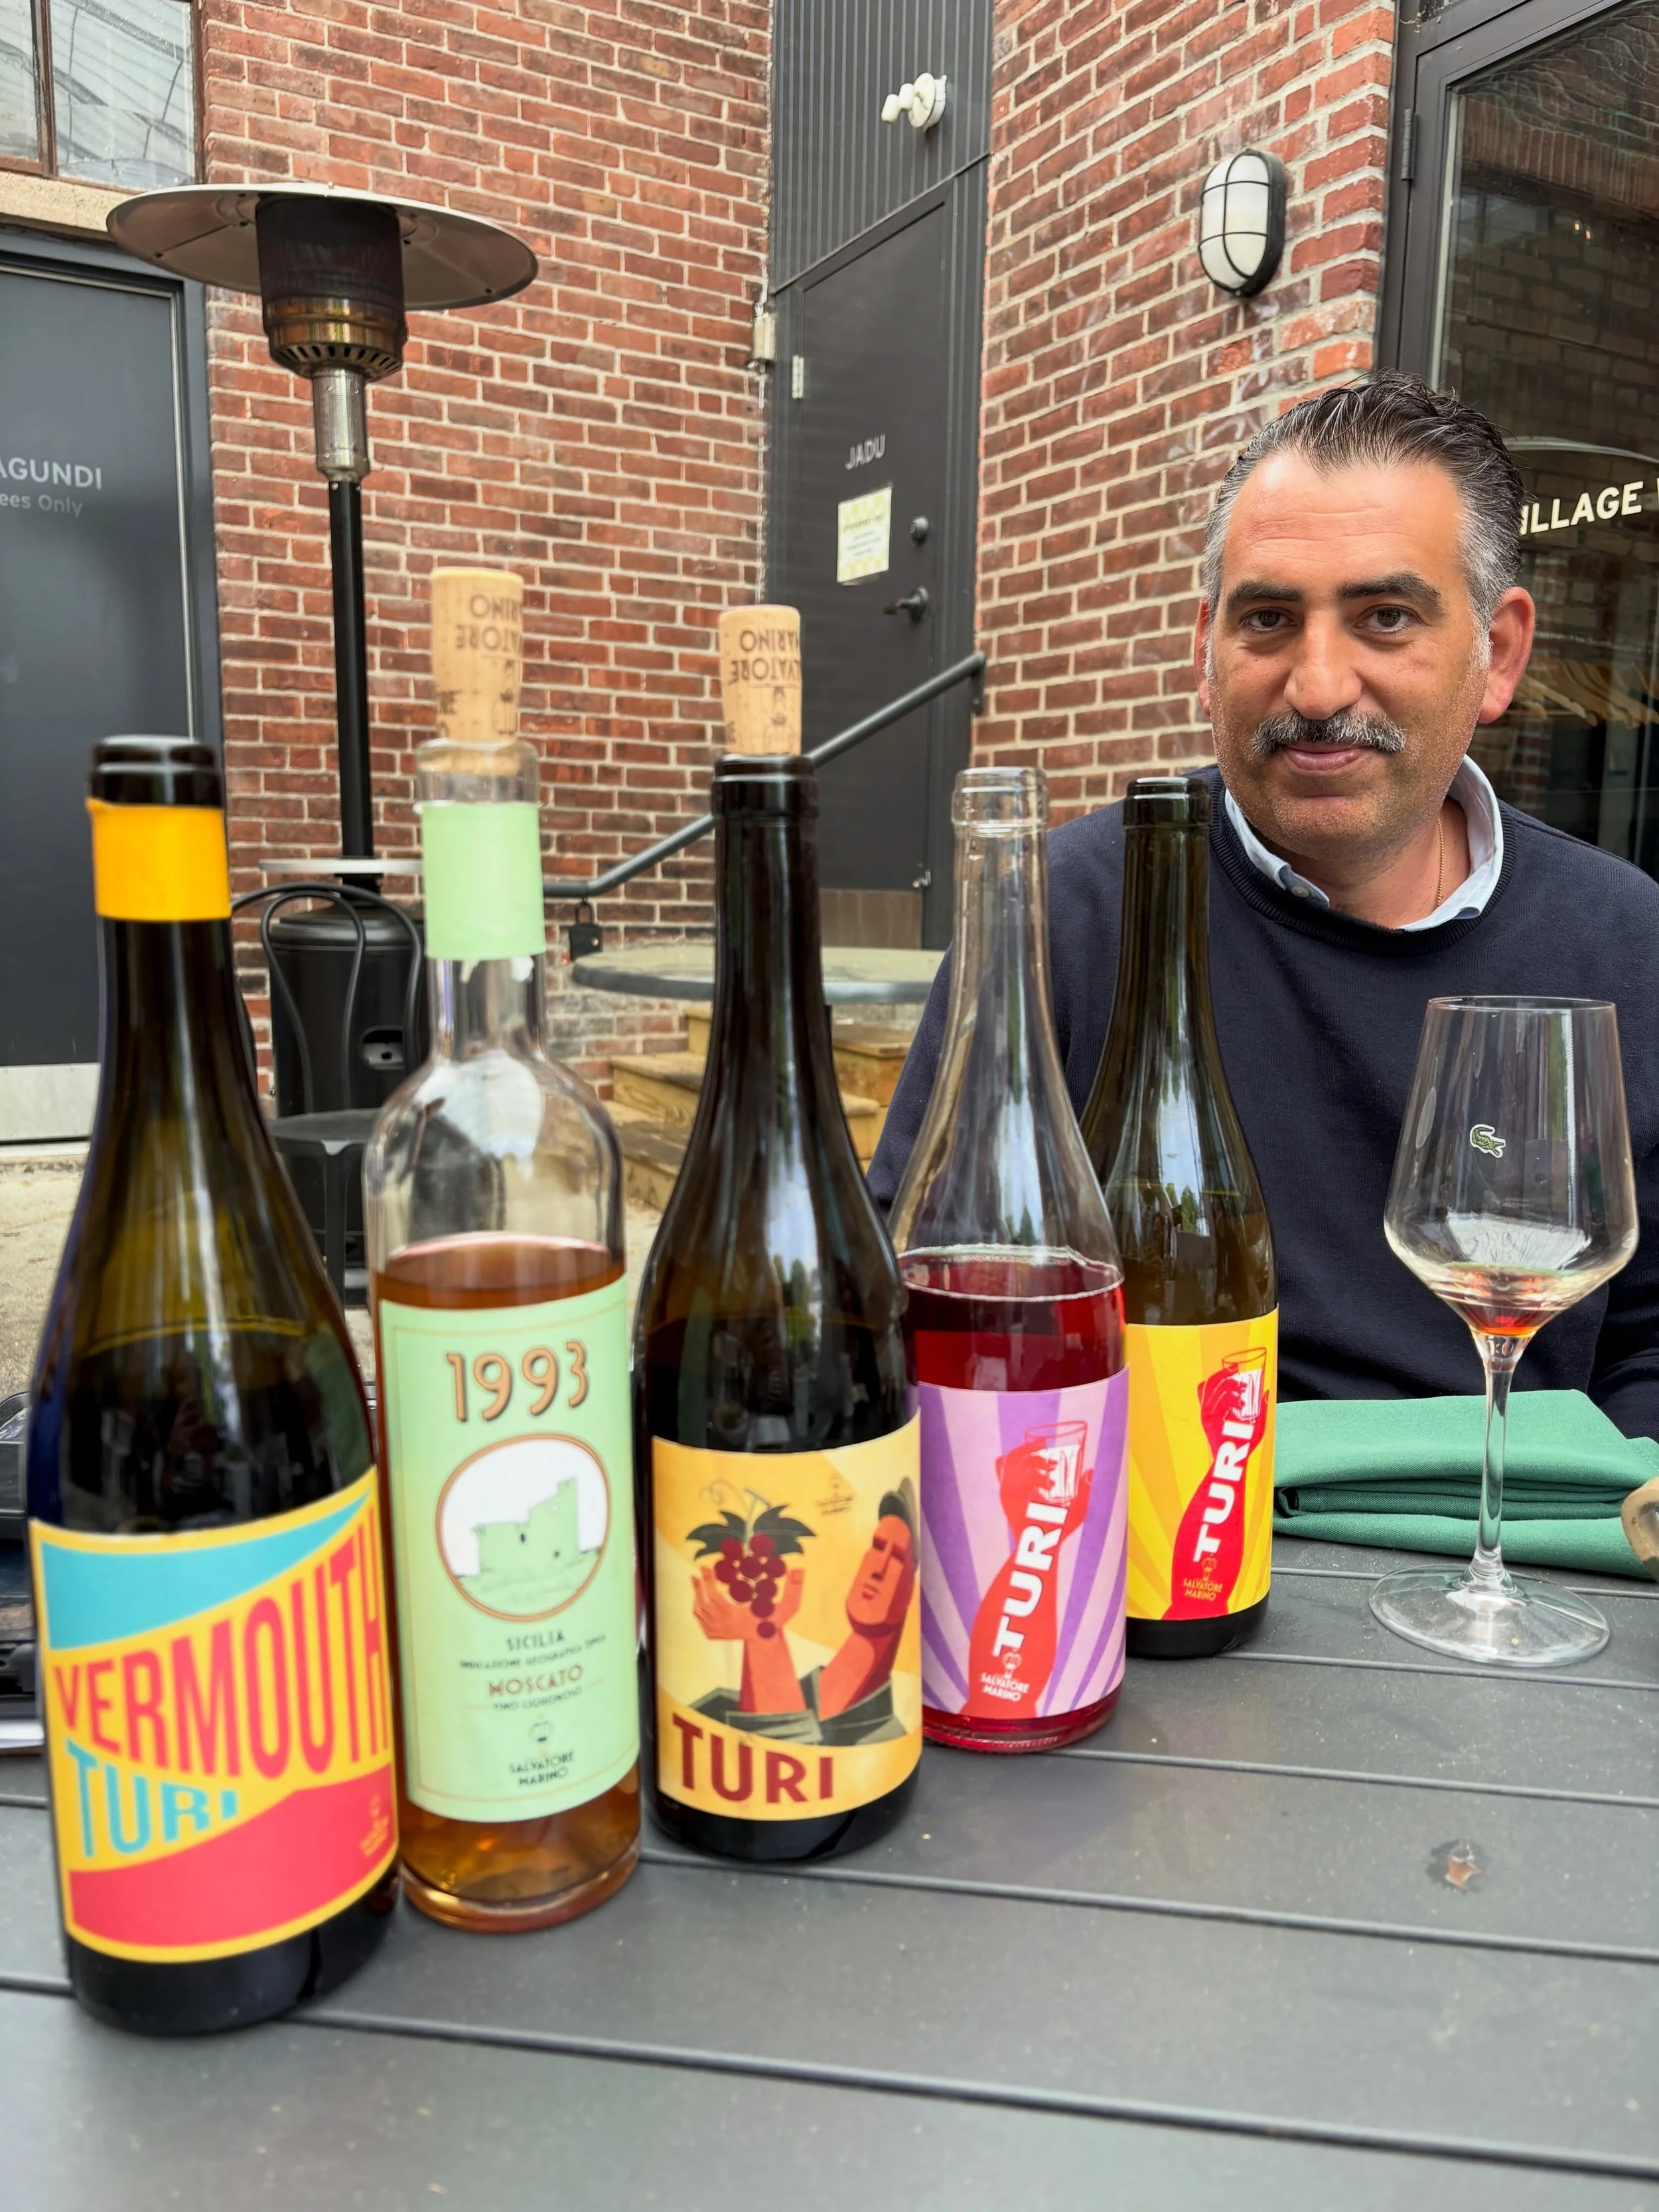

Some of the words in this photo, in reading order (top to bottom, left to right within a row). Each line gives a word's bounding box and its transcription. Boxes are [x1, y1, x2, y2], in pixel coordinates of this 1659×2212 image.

[845, 434, 886, 470] JADU
[38, 494, 82, 518] Only
[445, 1340, 589, 1423] 1993
[1192, 1421, 1256, 1563] TURI
[992, 1500, 1069, 1658] TURI
[1183, 1577, 1223, 1594] SALVATORE
[1185, 1588, 1216, 1601] MARINO
[52, 1505, 390, 1781] VERMOUTH
[507, 1629, 565, 1651] SICILIA
[488, 1664, 583, 1697] MOSCATO
[980, 1672, 1031, 1695] SALVATORE
[983, 1684, 1022, 1702] MARINO
[509, 1750, 575, 1774] SALVATORE
[672, 1710, 835, 1805] TURI
[518, 1765, 569, 1787] MARINO
[65, 1737, 239, 1858] TURI
